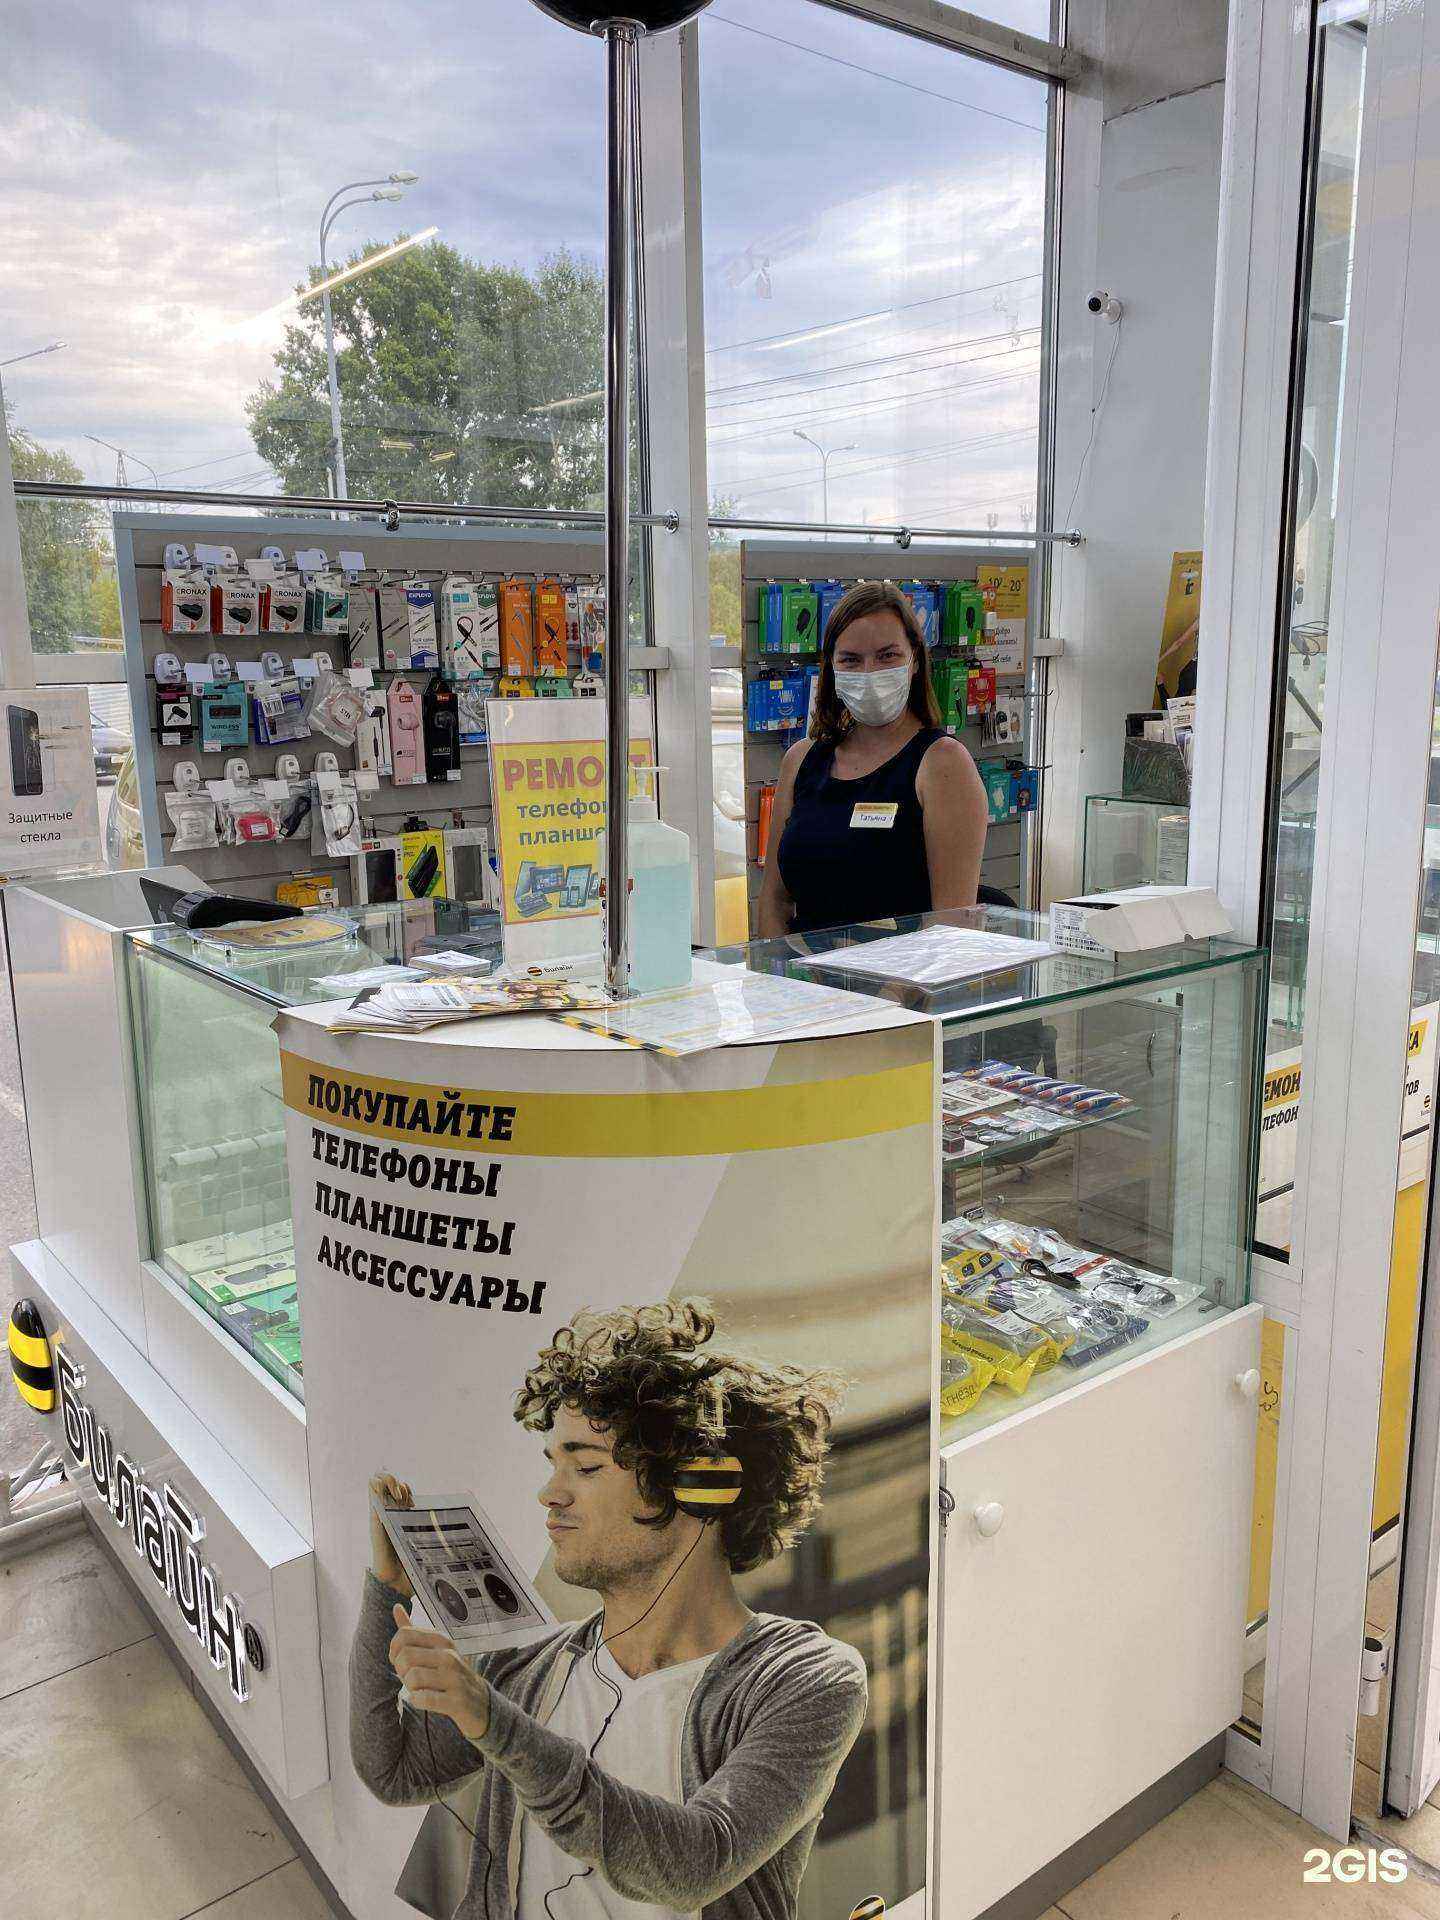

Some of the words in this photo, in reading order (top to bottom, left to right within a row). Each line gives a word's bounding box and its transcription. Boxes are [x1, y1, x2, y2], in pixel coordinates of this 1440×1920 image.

[503, 753, 646, 792] РЕМОТ
[8, 811, 73, 824] Защитные
[20, 831, 61, 843] стекла
[308, 1073, 517, 1141] ПОКУПАЙТЕ
[312, 1127, 502, 1197] ТЕЛЕФОНЫ
[314, 1181, 516, 1255] ПЛАНШЕТЫ
[317, 1235, 547, 1314] АКСЕССУАРЫ
